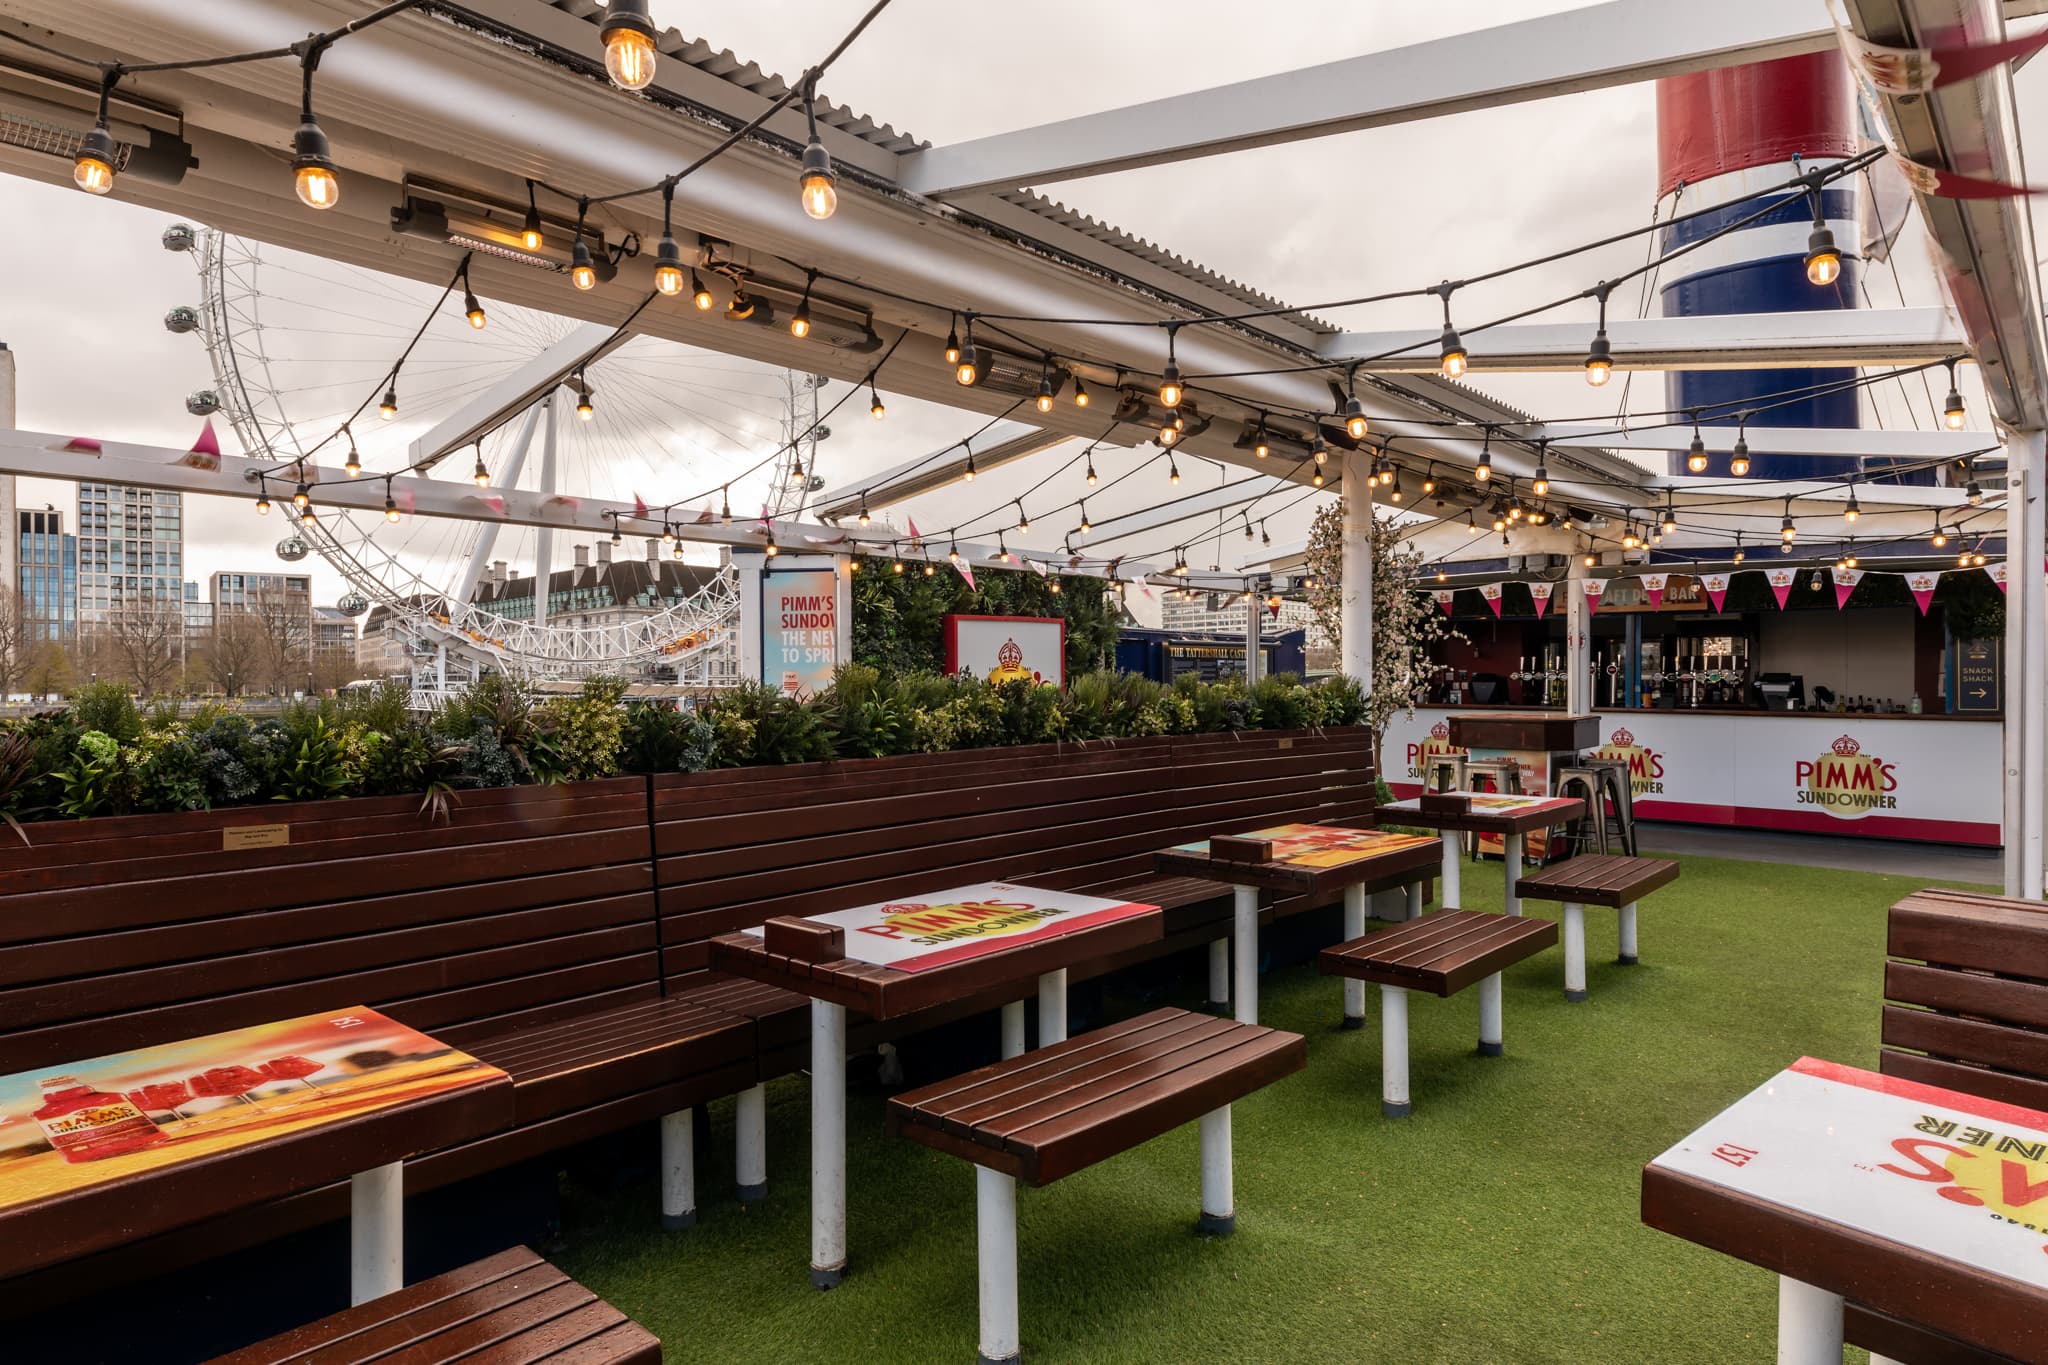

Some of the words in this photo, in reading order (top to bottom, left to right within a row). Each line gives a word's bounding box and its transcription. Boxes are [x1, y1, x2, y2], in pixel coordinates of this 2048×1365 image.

[1669, 587, 1697, 601] BAR
[781, 595, 834, 611] PIMM'S
[781, 613, 835, 629] SUNDO
[781, 630, 806, 646] THE
[781, 647, 800, 664] TO
[1169, 647, 1184, 658] THE
[1229, 649, 1248, 659] CAST
[1796, 758, 1898, 792] PIMM'S
[1797, 791, 1897, 809] SUNDOWNER
[856, 899, 1036, 940] PIMM'S
[910, 907, 1070, 946] SUNDOWNER
[47, 1106, 133, 1131] PIMM'S
[1913, 1114, 2048, 1165] NER
